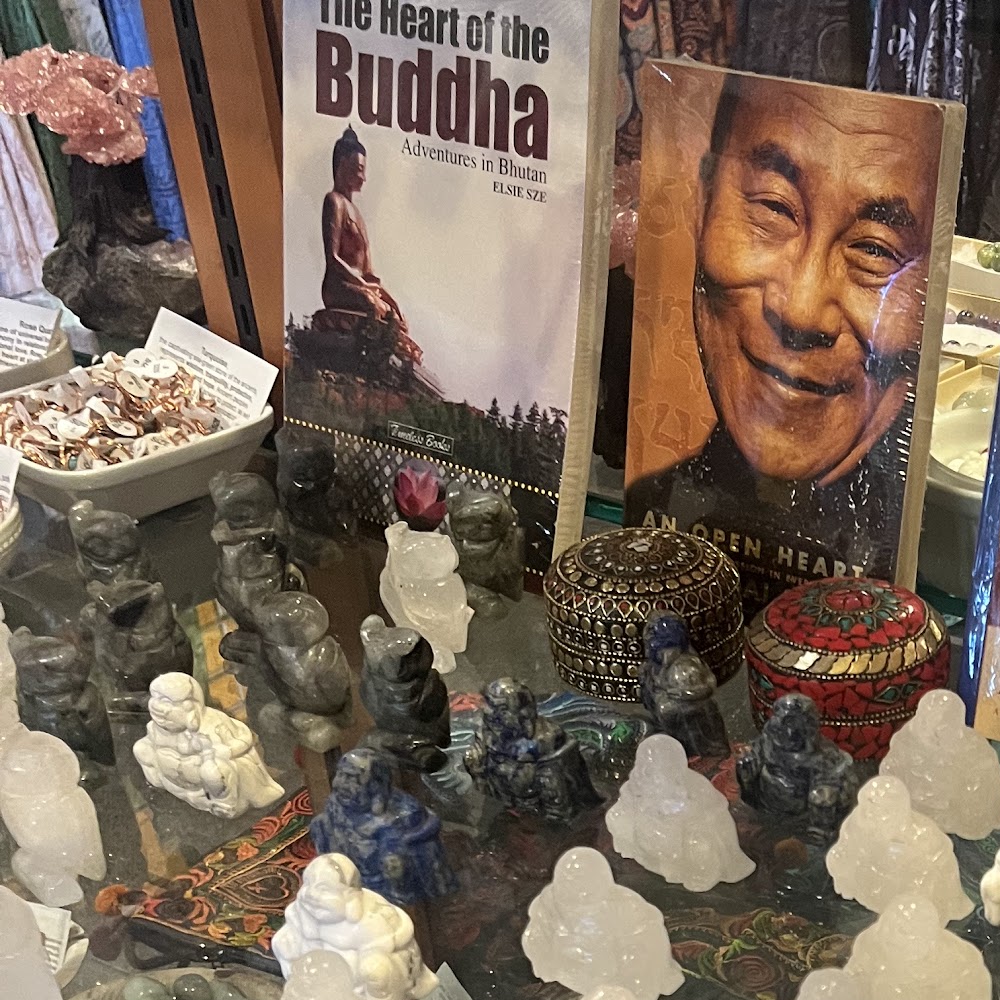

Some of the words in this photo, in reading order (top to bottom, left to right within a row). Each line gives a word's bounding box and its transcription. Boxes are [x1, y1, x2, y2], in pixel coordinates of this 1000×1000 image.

[380, 0, 459, 48] Heart
[466, 10, 496, 54] of
[500, 15, 550, 64] the
[315, 29, 549, 161] Buddha
[401, 138, 477, 169] Adventures
[481, 153, 494, 173] in
[498, 157, 547, 184] Bhutan
[492, 180, 524, 199] ELSIE
[526, 188, 547, 204] SZE
[642, 510, 677, 532] AN
[691, 523, 762, 559] OPEN
[777, 545, 864, 578] HEART
